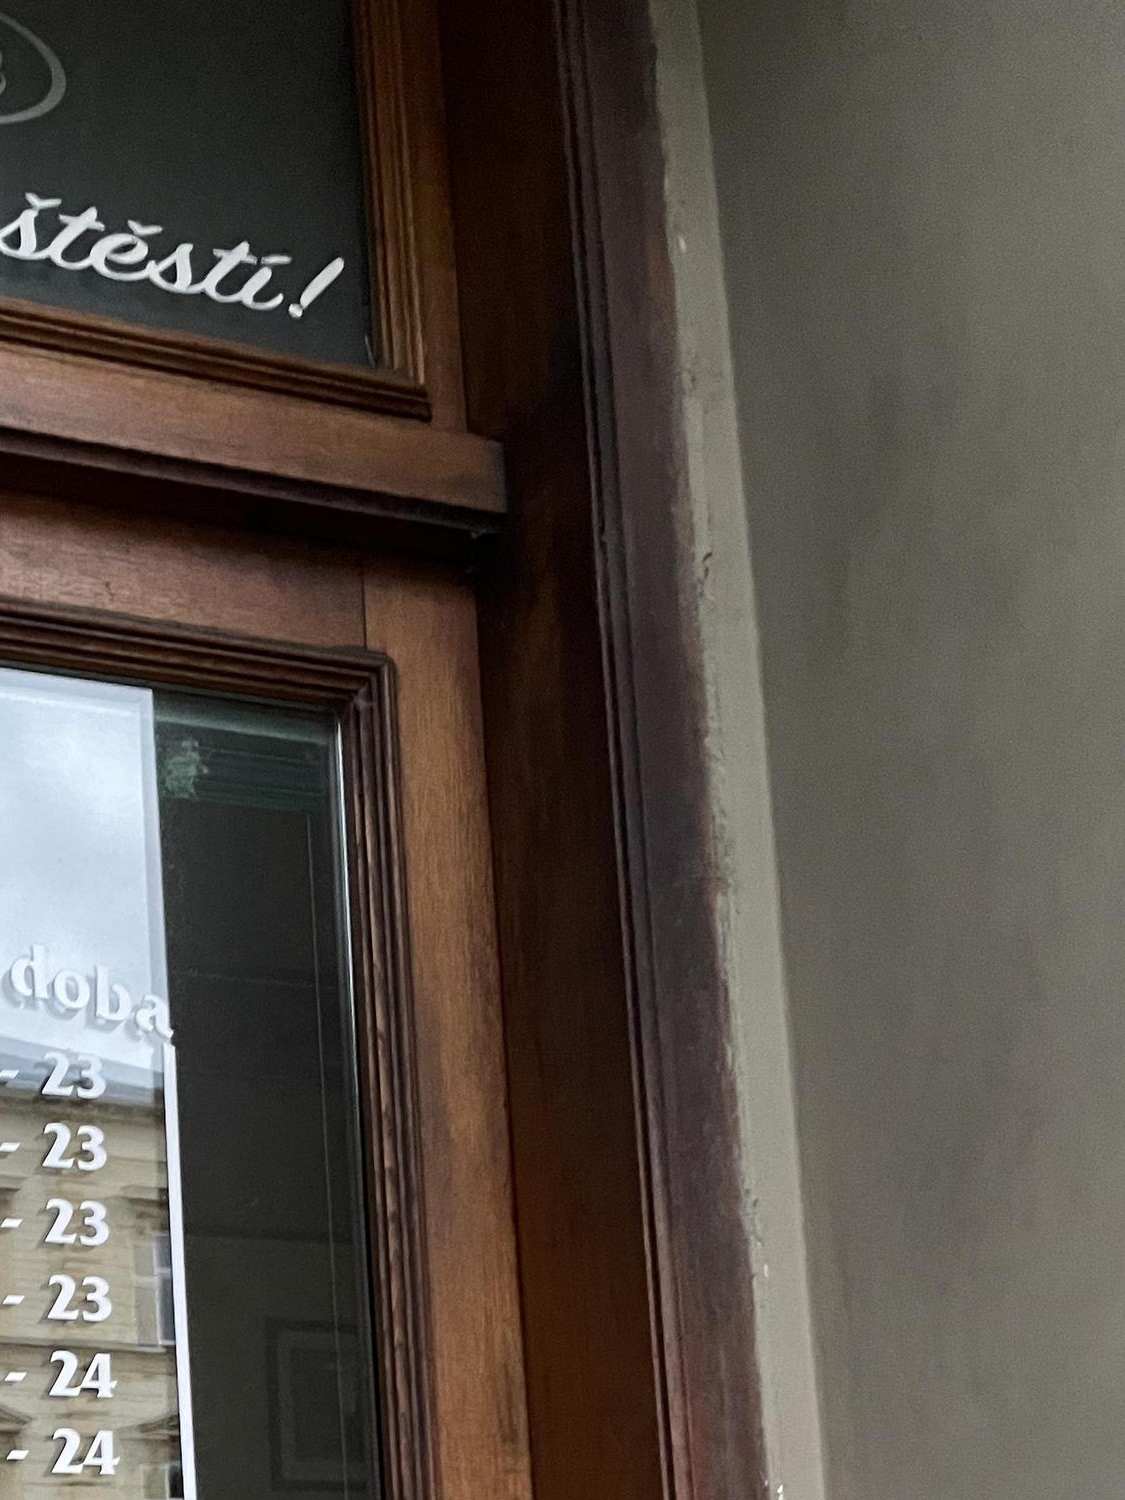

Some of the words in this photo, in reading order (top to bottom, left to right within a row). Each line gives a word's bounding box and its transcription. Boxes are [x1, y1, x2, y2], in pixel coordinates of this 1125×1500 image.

[10, 944, 174, 1039] doba
[42, 1052, 106, 1098] 23
[42, 1122, 107, 1171] 23
[1, 1219, 22, 1228] -
[45, 1199, 110, 1246] 23
[2, 1295, 25, 1306] -
[47, 1275, 112, 1321] 23
[5, 1371, 27, 1382] -
[49, 1350, 117, 1398] 24
[7, 1450, 29, 1460] -
[51, 1428, 119, 1475] 24
